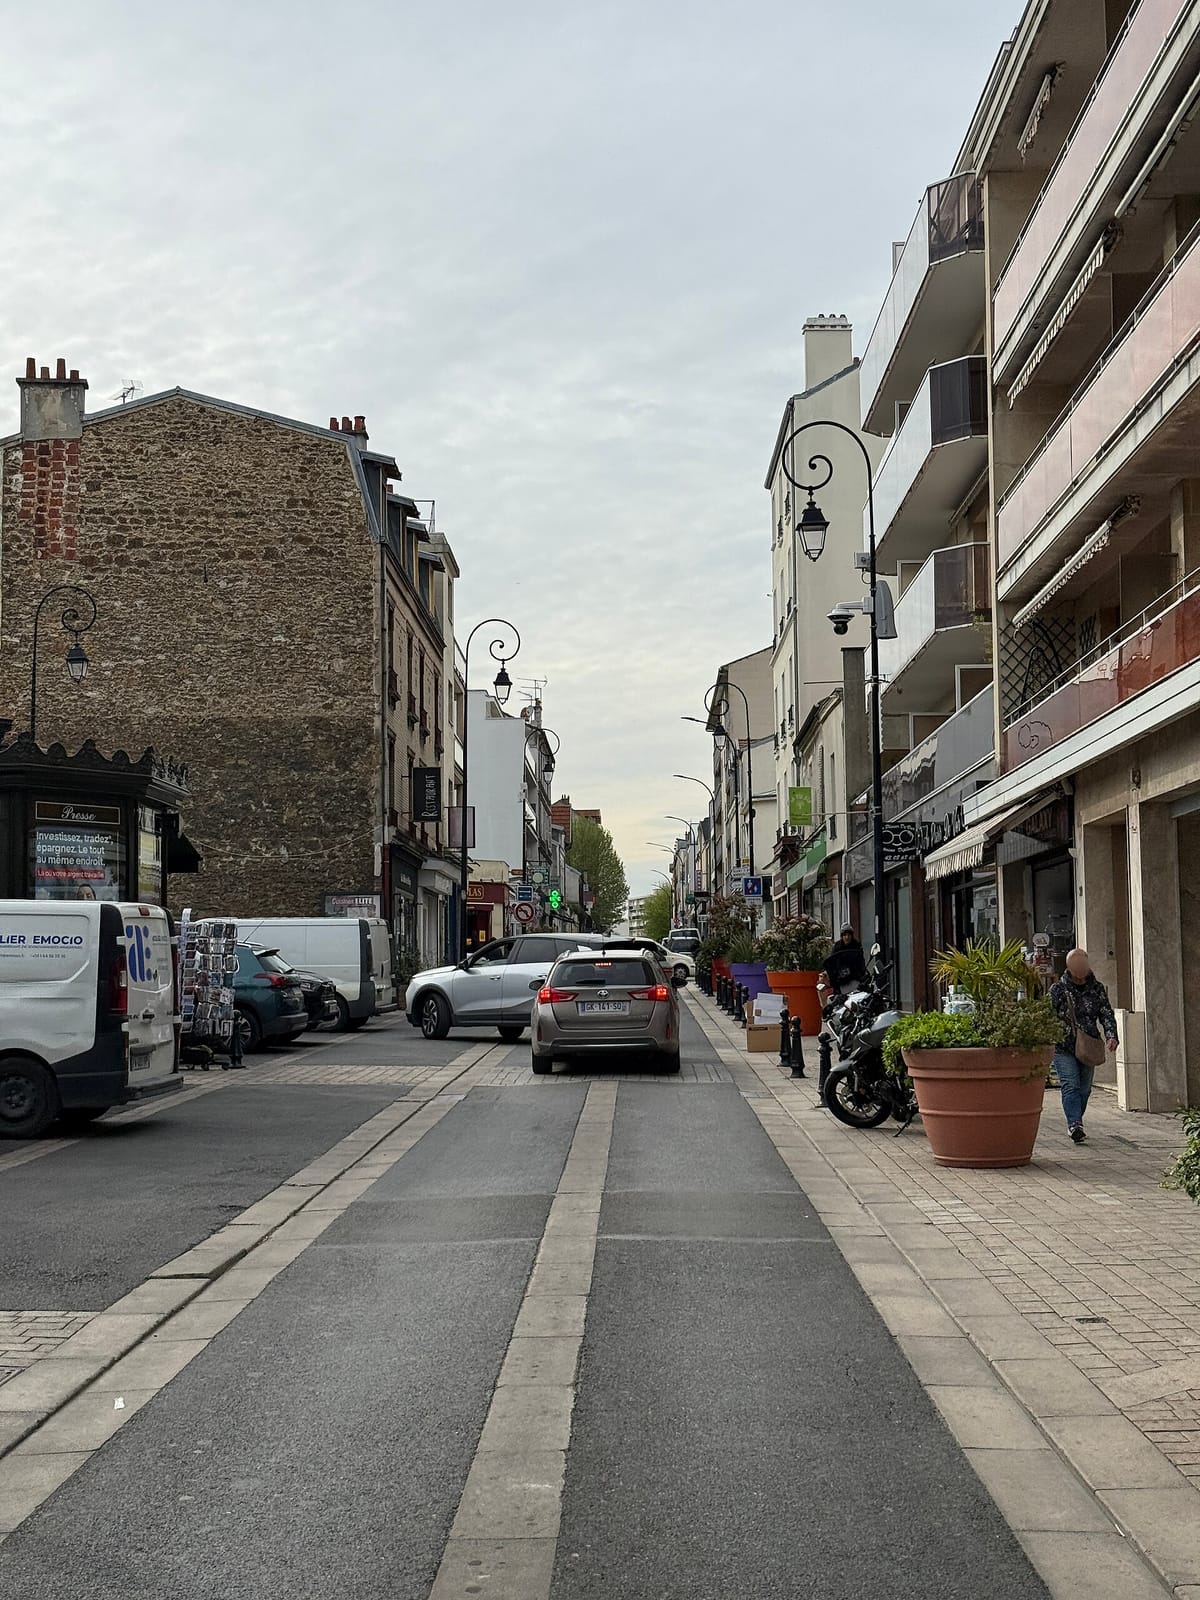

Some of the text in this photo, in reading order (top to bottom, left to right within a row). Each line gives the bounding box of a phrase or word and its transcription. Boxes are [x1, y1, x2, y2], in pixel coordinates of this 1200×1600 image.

[61, 805, 97, 821] Presse
[36, 831, 83, 843] Investissez,
[36, 842, 105, 855] épargnez. Le tout
[37, 854, 106, 866] au même endroit.
[355, 897, 373, 905] ELITE
[33, 935, 83, 945] EMOCIO
